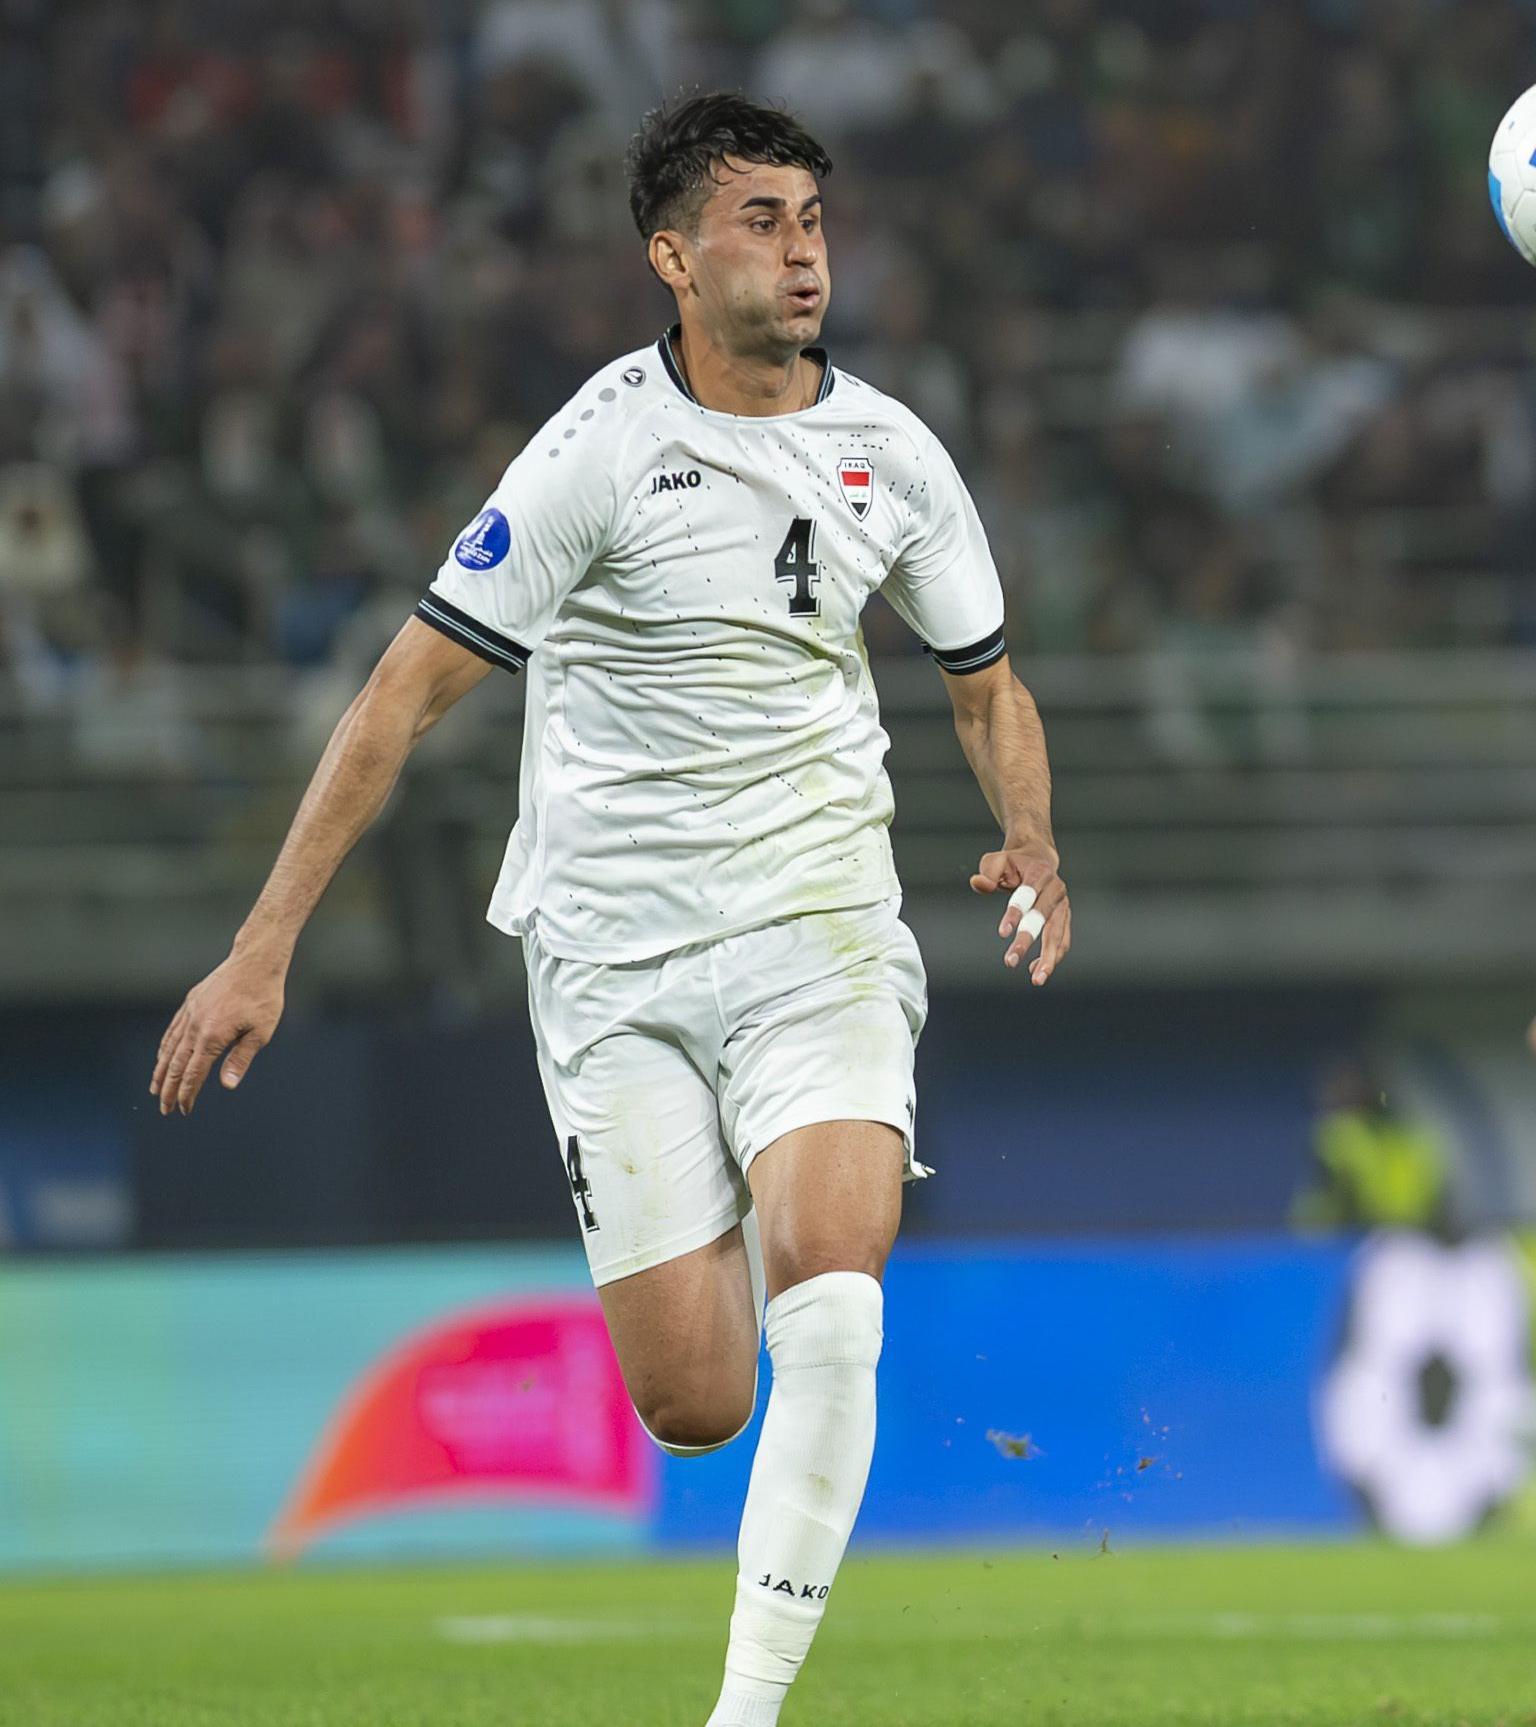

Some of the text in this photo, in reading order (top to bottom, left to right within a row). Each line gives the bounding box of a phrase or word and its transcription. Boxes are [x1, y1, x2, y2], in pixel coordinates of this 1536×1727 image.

[651, 470, 701, 495] JAKO
[775, 518, 821, 618] 4
[759, 1574, 829, 1599] JAKO
